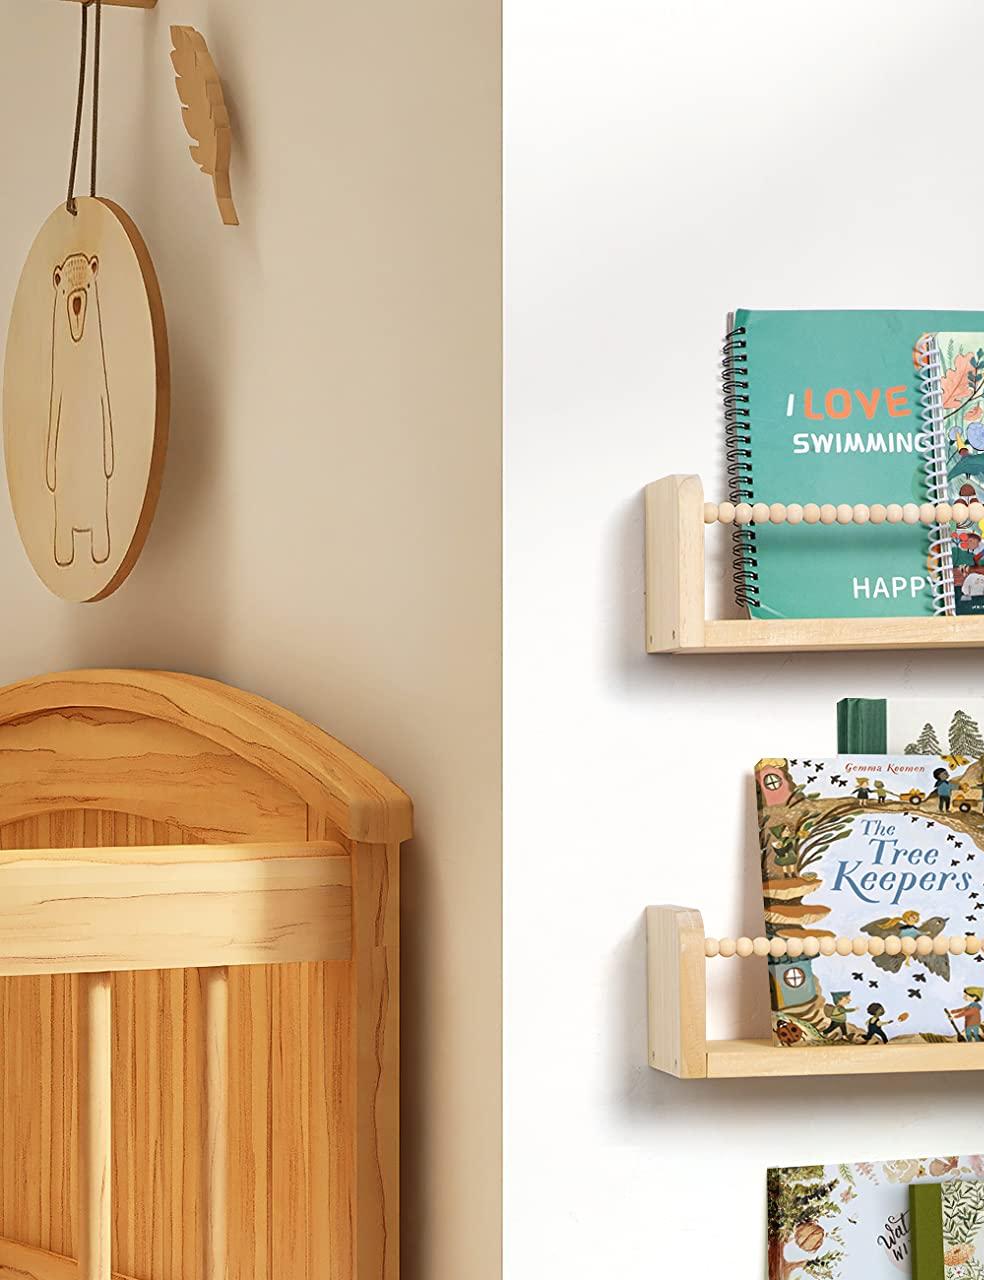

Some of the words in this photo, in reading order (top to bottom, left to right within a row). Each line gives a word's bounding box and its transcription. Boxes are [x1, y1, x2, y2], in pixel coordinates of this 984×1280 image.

[786, 393, 795, 417] I
[804, 384, 912, 421] LOVE
[845, 763, 882, 773] Gemma
[861, 819, 896, 836] The
[868, 838, 939, 866] Tree
[830, 860, 973, 905] Keepers
[877, 1209, 911, 1250] Wat
[892, 1240, 912, 1261] WI
